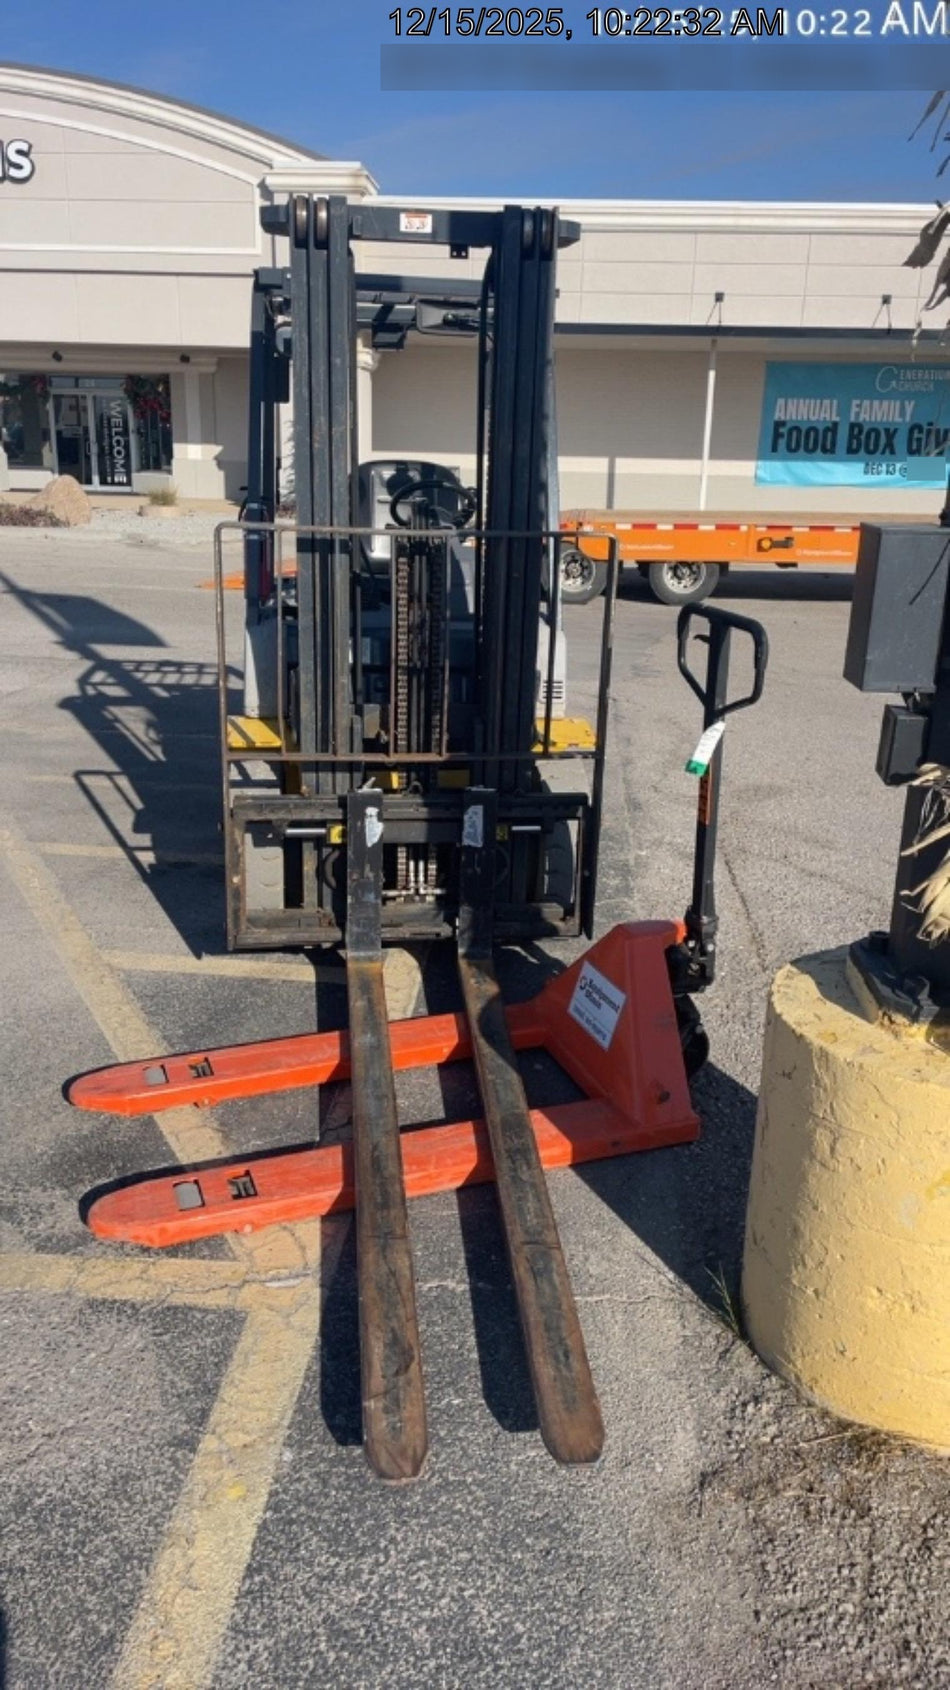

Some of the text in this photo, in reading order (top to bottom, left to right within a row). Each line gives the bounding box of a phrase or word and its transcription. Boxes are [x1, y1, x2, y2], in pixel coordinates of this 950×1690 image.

[773, 397, 916, 423] ANNUAL FAMILY
[109, 399, 127, 484] WELCOME
[770, 420, 840, 455] Food
[846, 421, 899, 456] Box
[863, 461, 883, 476] DEC
[885, 462, 896, 476] 13
